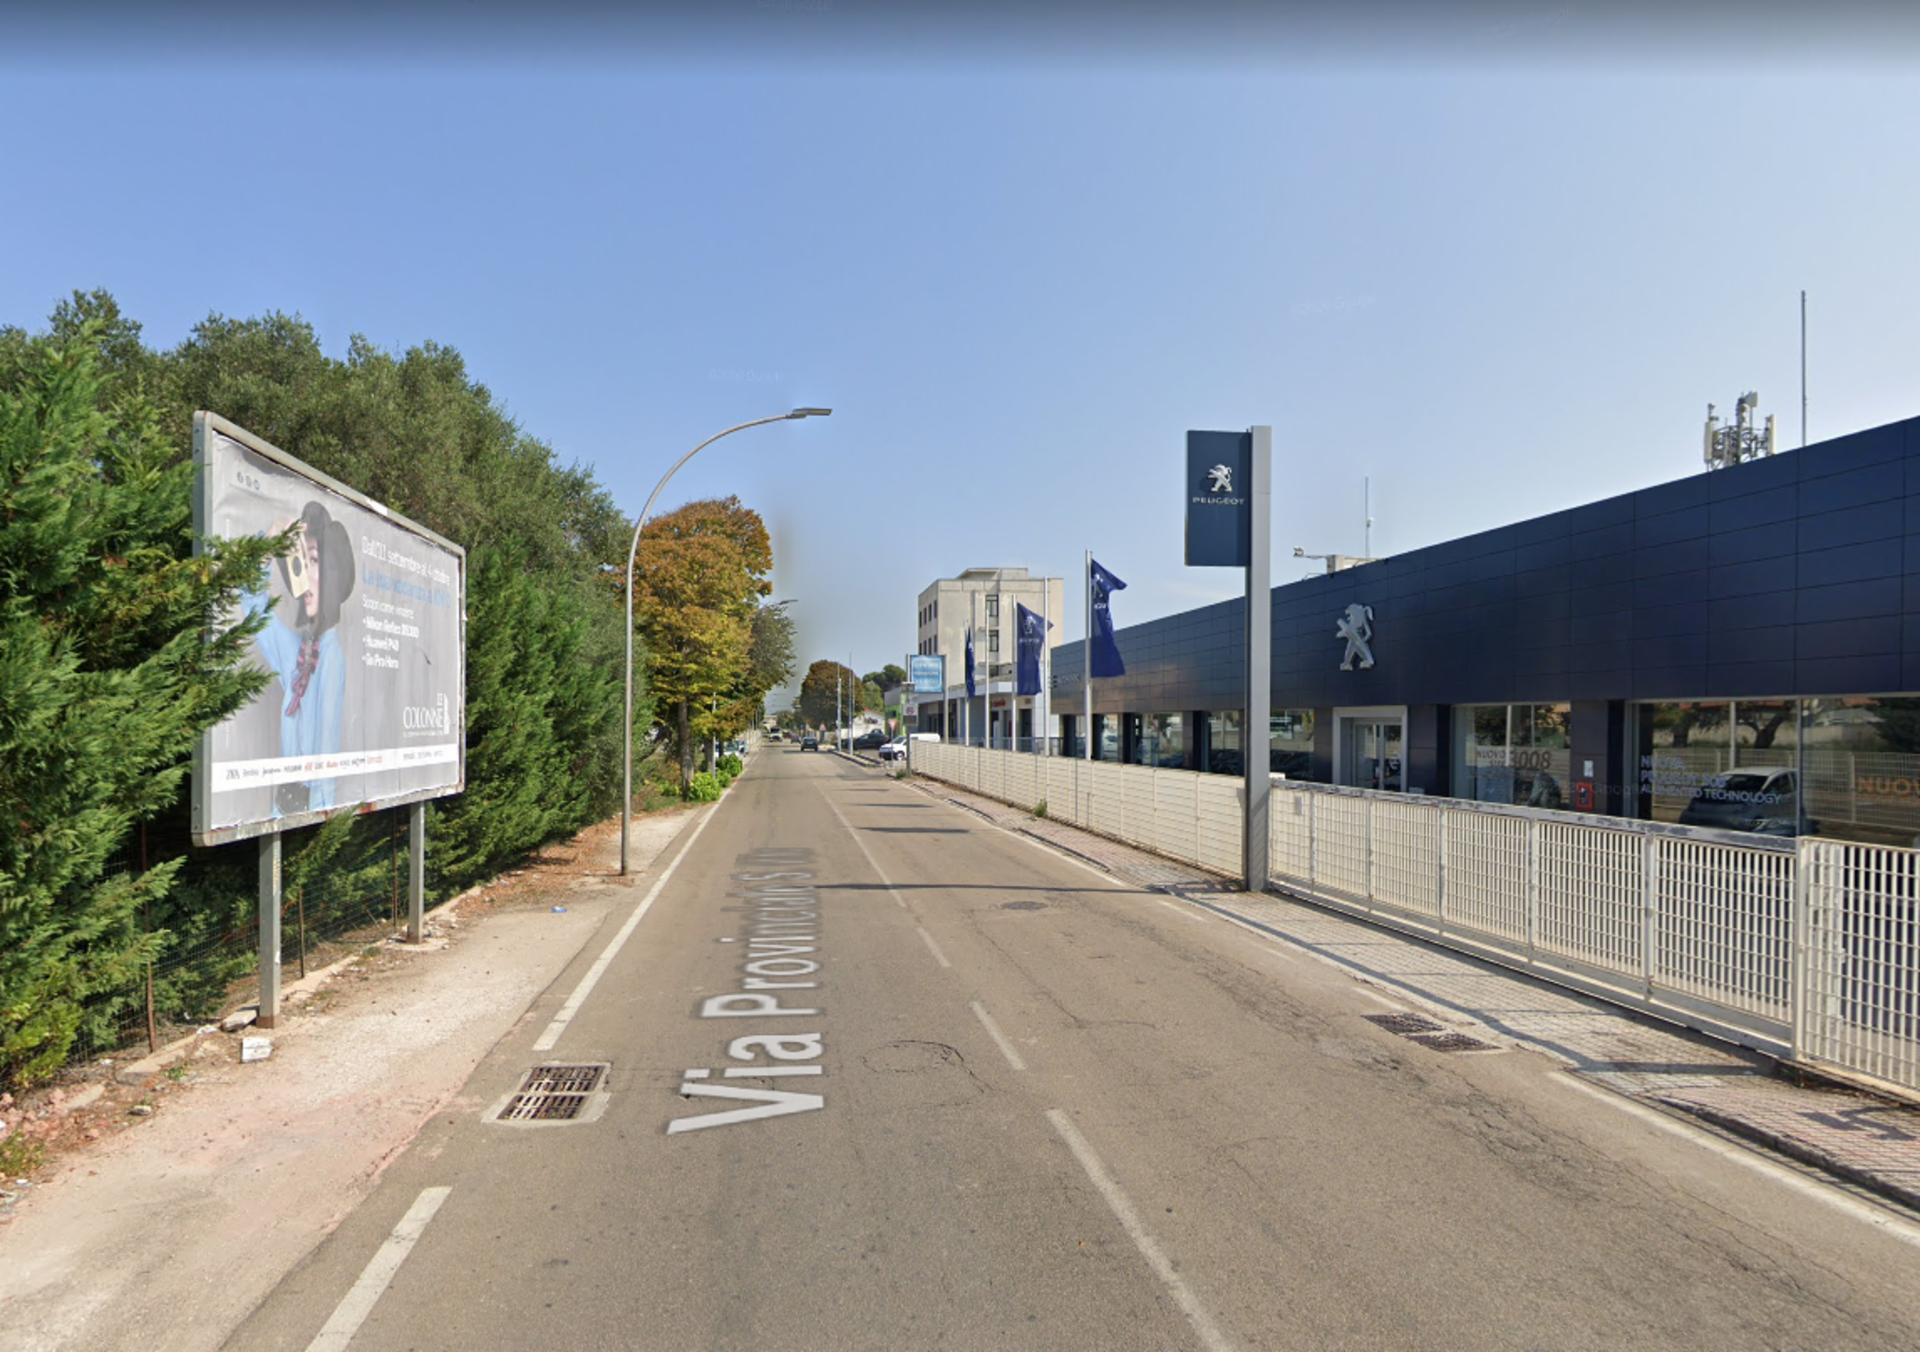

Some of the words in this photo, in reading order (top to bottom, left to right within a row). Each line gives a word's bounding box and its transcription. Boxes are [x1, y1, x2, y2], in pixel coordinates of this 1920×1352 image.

[1192, 496, 1245, 505] PEUGEOT
[1509, 750, 1553, 769] 3008
[1703, 788, 1783, 805] TECHNOLOGY
